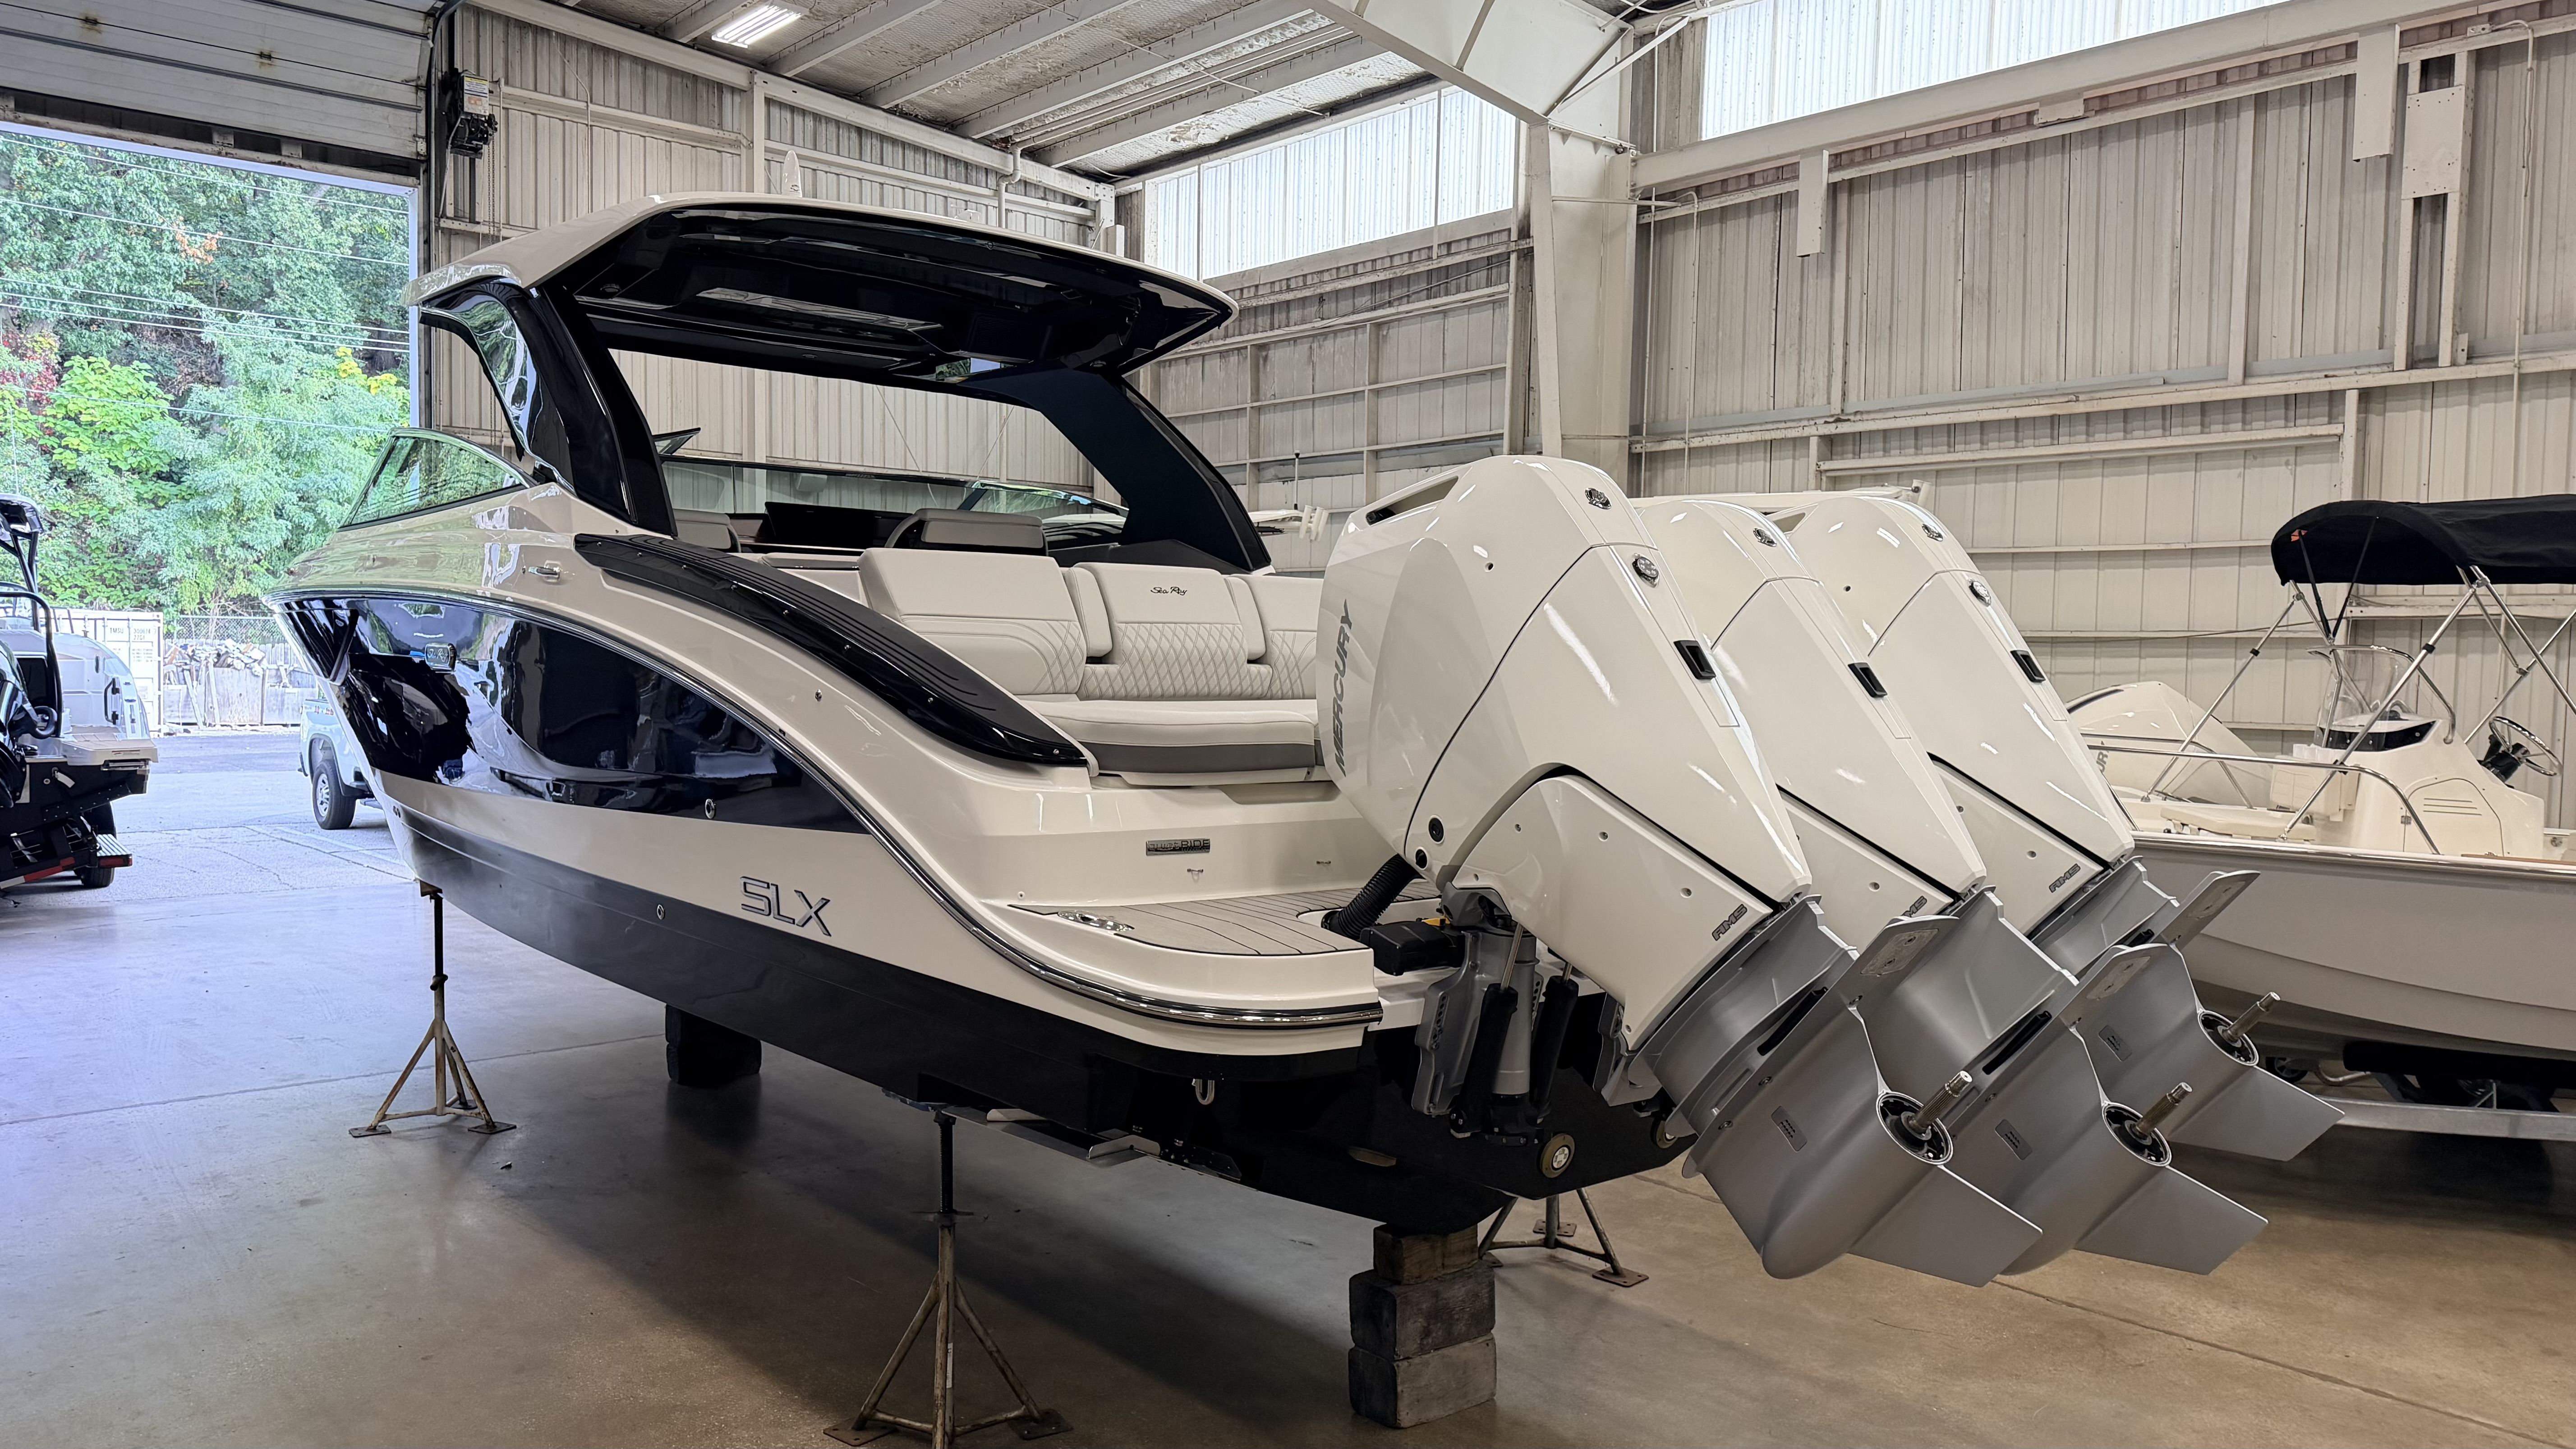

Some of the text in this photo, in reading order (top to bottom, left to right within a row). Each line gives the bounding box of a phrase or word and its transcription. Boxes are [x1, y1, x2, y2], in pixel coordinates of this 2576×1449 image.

[1170, 586, 1187, 596] Ray
[1333, 598, 1352, 777] MERCURY
[2049, 863, 2081, 893] AMS
[740, 876, 832, 937] SLX
[1711, 903, 1748, 941] AMS
[1900, 896, 1927, 918] MS
